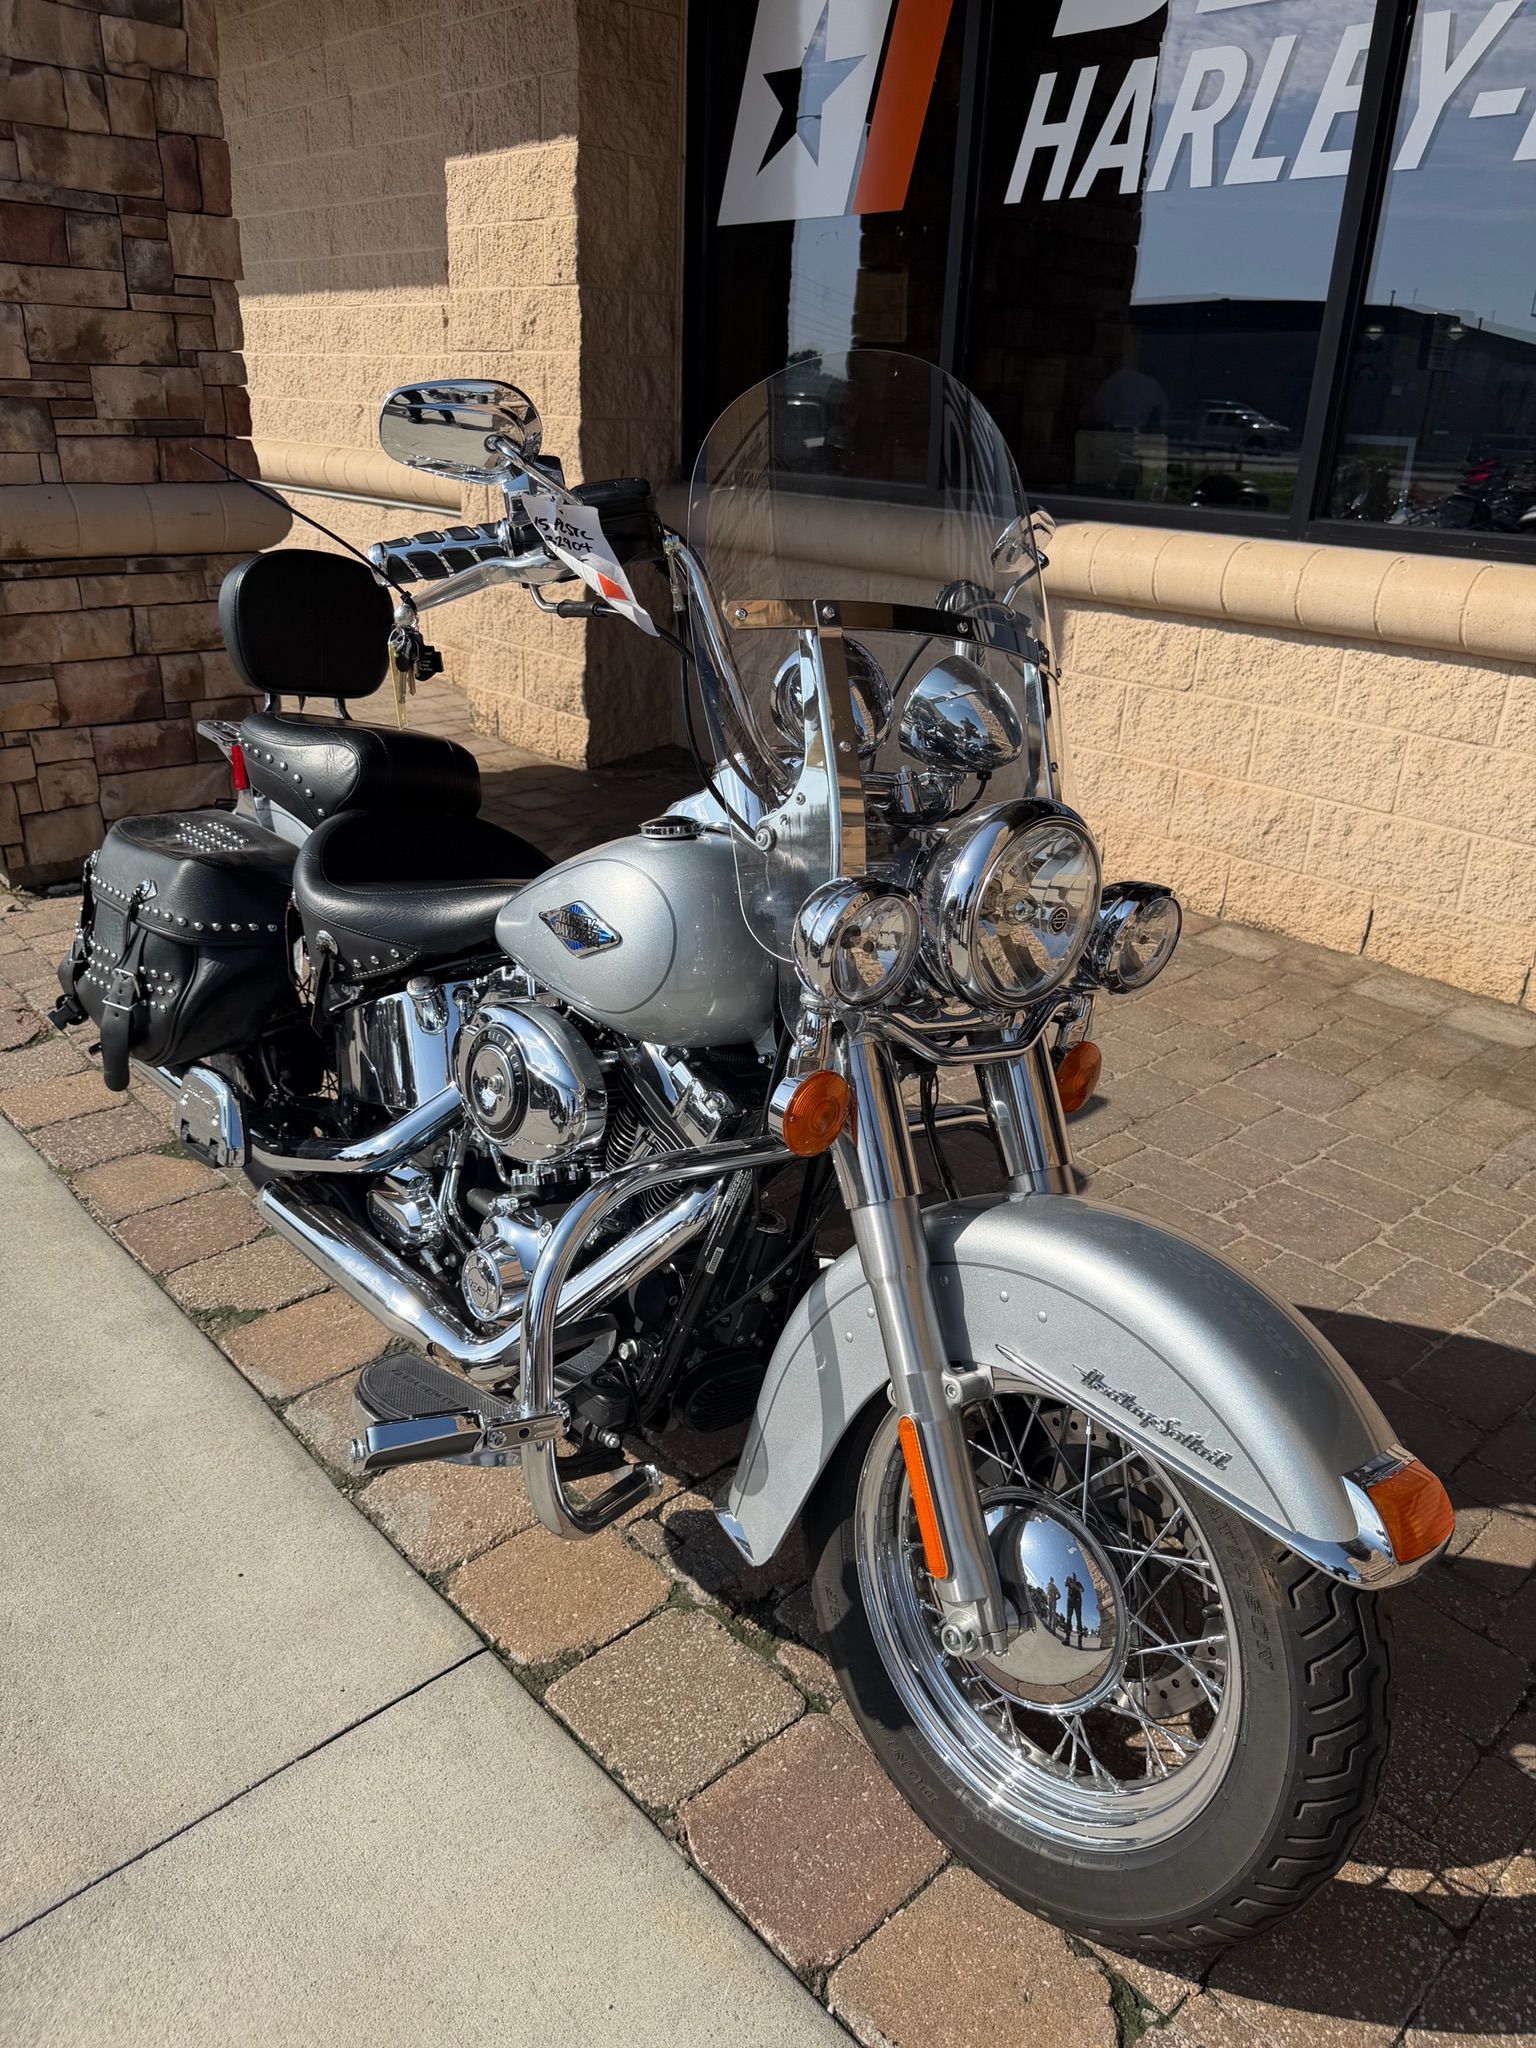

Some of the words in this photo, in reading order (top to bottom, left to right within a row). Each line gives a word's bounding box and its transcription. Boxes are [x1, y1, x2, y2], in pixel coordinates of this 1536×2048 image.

[1003, 0, 1536, 205] HARLEY-
[534, 516, 550, 531] 15
[502, 1039, 523, 1087] INCHES
[1162, 1417, 1234, 1471] Softail
